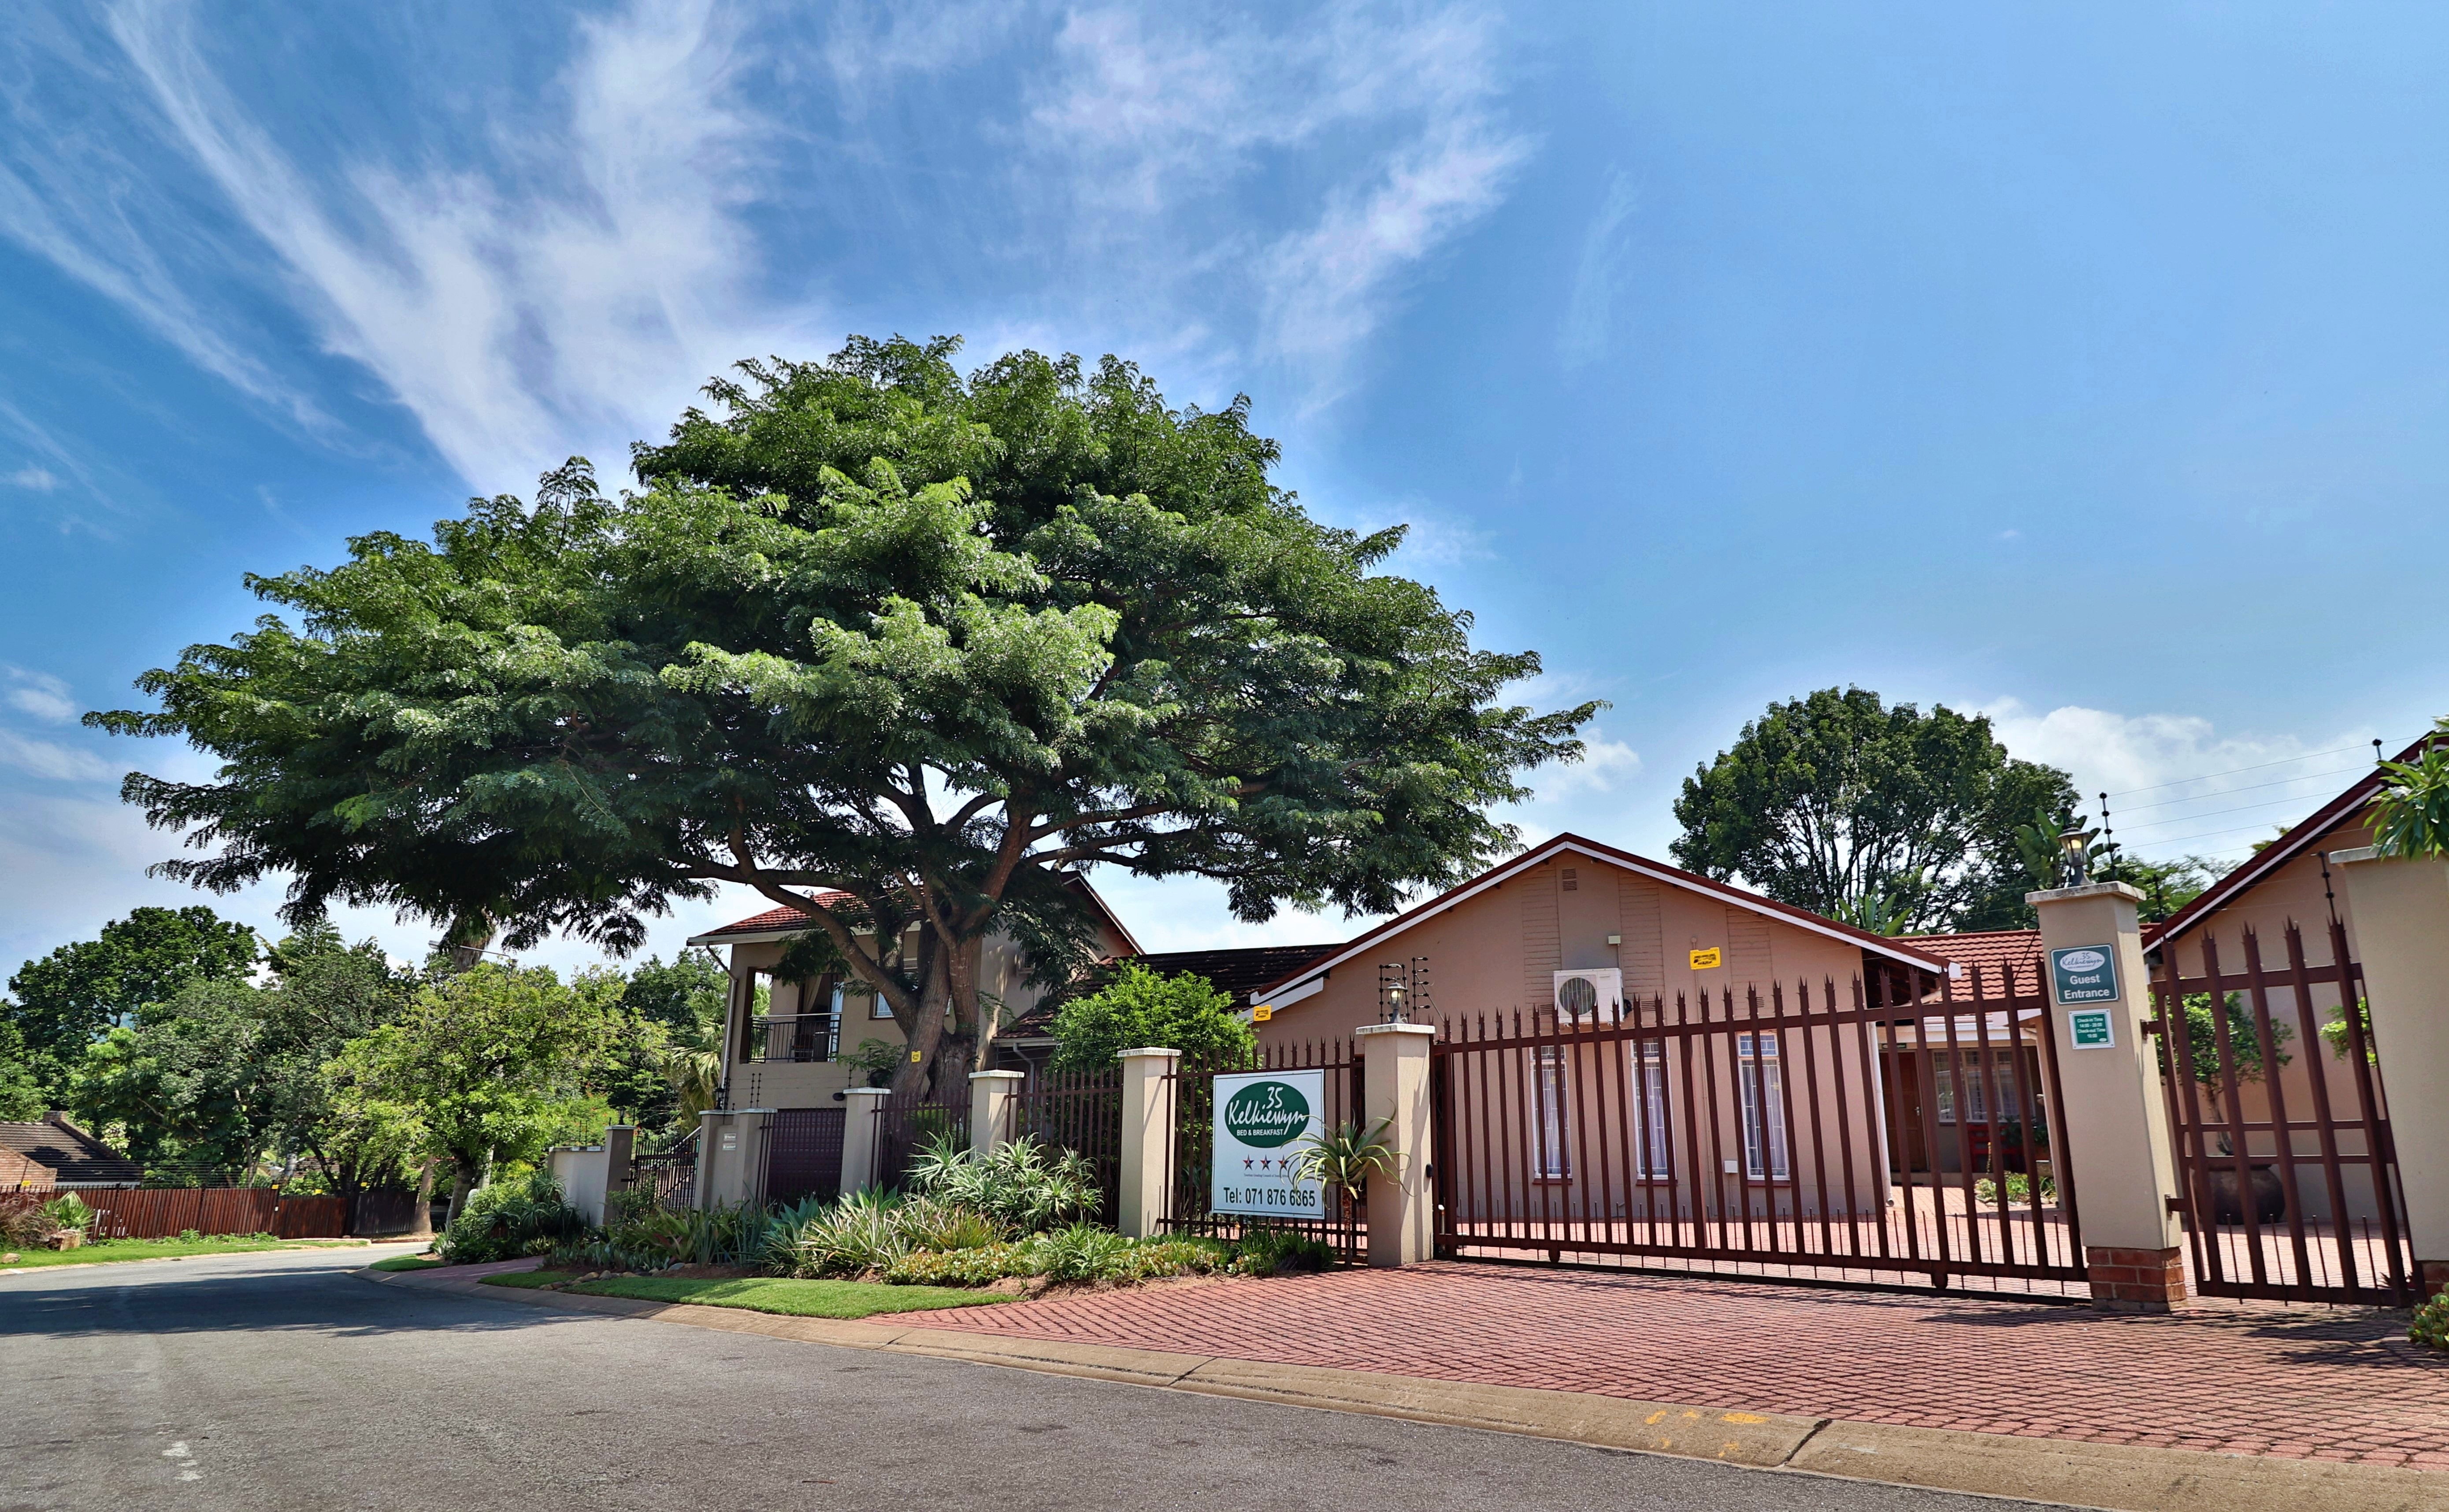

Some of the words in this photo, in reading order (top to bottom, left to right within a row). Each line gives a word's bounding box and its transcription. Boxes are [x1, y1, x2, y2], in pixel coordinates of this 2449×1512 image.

[2070, 974, 2100, 985] Guest
[2064, 989, 2110, 999] Entrance
[1266, 1086, 1283, 1109] 35
[1228, 1100, 1306, 1135] Kelkiewyn
[1224, 1187, 1241, 1204] Tel:
[1246, 1188, 1262, 1204] 071
[1267, 1189, 1286, 1205] 876
